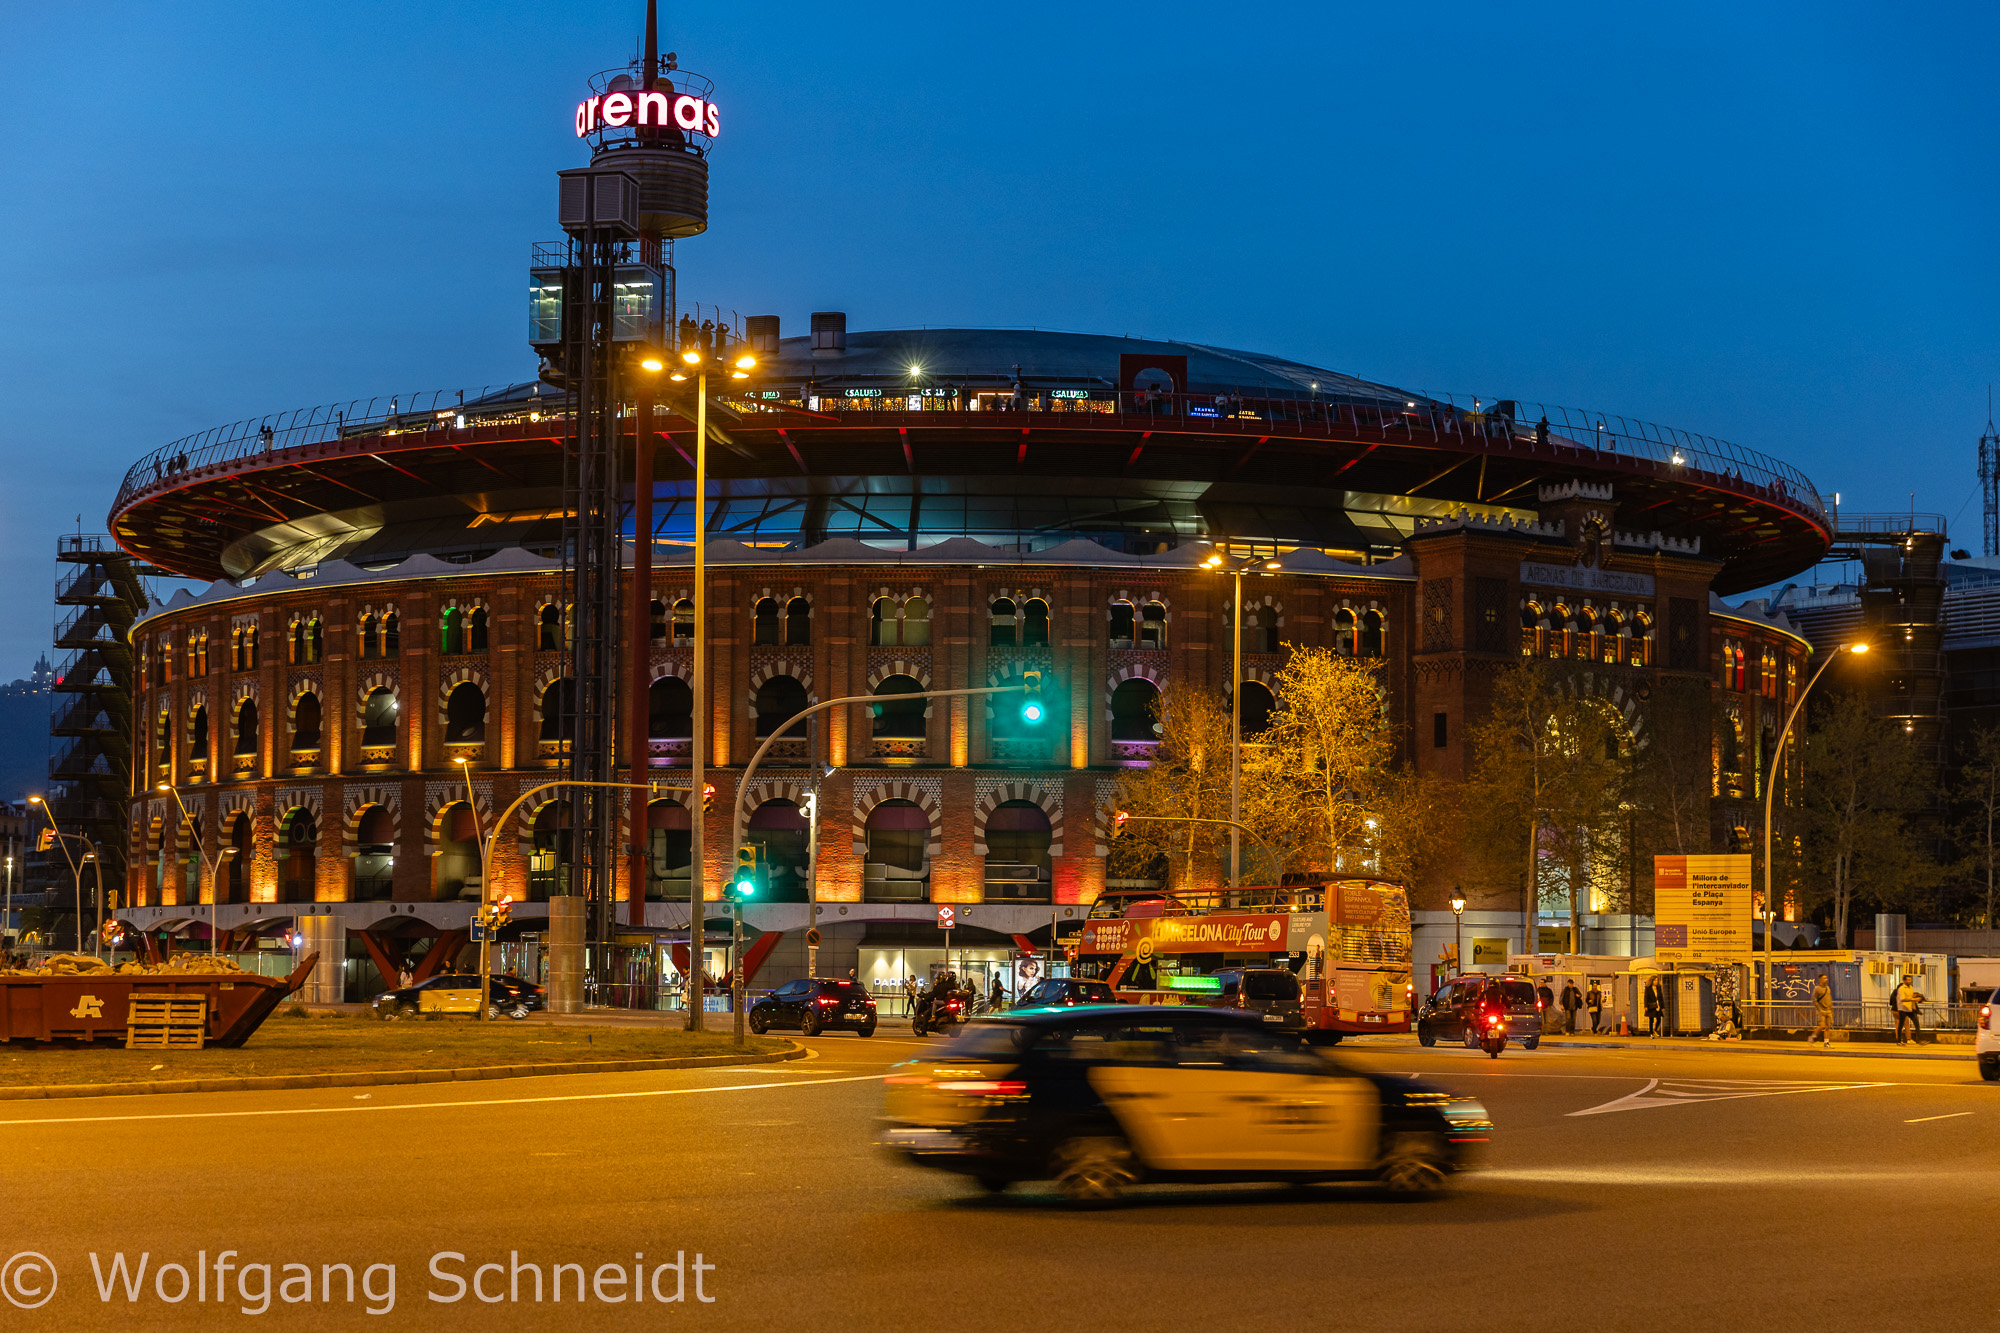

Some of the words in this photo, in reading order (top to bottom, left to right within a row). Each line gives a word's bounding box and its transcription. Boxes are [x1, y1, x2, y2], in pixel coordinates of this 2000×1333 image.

[575, 91, 720, 138] arenas
[1527, 566, 1565, 584] ARENAS
[1571, 571, 1584, 586] DE
[1692, 882, 1749, 890] l'intercanviador
[1343, 889, 1363, 897] POBLE
[1703, 891, 1724, 899] Plaça
[1344, 895, 1372, 904] ESPANYOL
[1692, 899, 1723, 907] Espanya
[1709, 928, 1737, 936] Europea
